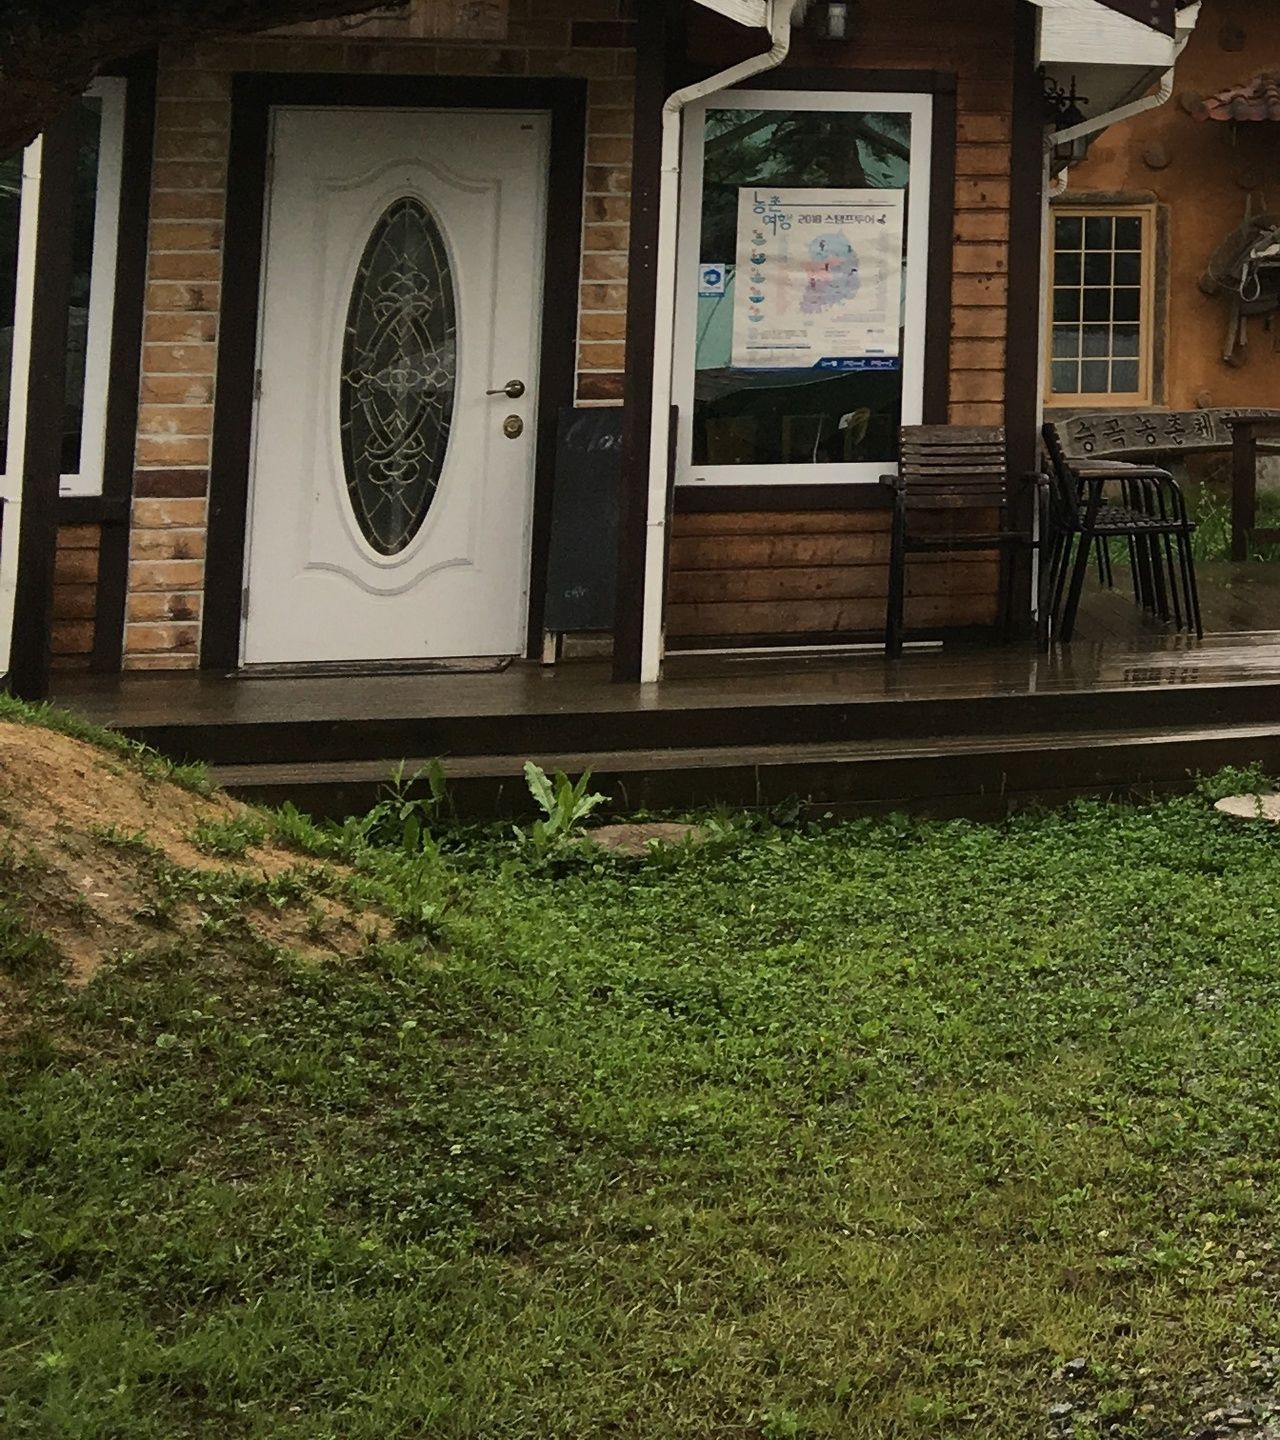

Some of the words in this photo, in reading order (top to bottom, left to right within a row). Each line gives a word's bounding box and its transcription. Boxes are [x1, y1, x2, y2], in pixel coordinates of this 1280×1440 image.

[752, 190, 783, 215] 농촌
[762, 213, 793, 237] 여행
[797, 213, 823, 225] 2018
